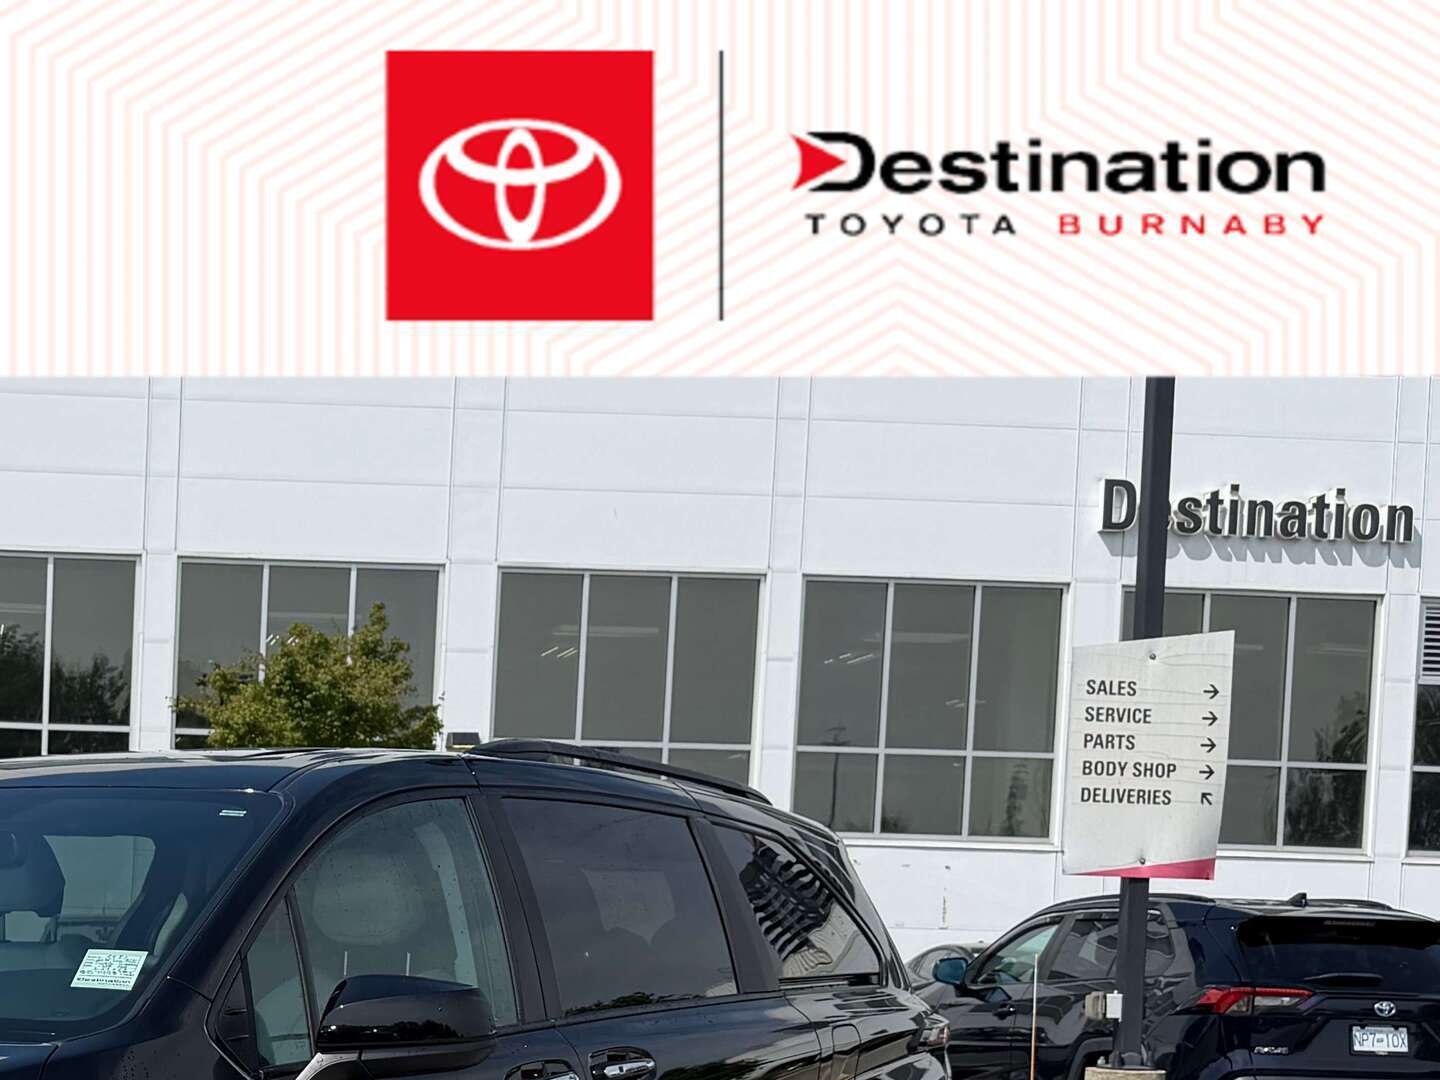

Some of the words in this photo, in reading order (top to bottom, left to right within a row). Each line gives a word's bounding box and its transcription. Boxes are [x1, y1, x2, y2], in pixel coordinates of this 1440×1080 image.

[1100, 478, 1415, 543] Dstination
[1085, 679, 1137, 697] SALES
[1084, 706, 1152, 724] SERVICE
[1083, 734, 1136, 751] PARTS
[1081, 760, 1128, 778] BODY
[1132, 761, 1177, 779] SHOP
[1080, 788, 1172, 806] DELIVERIES
